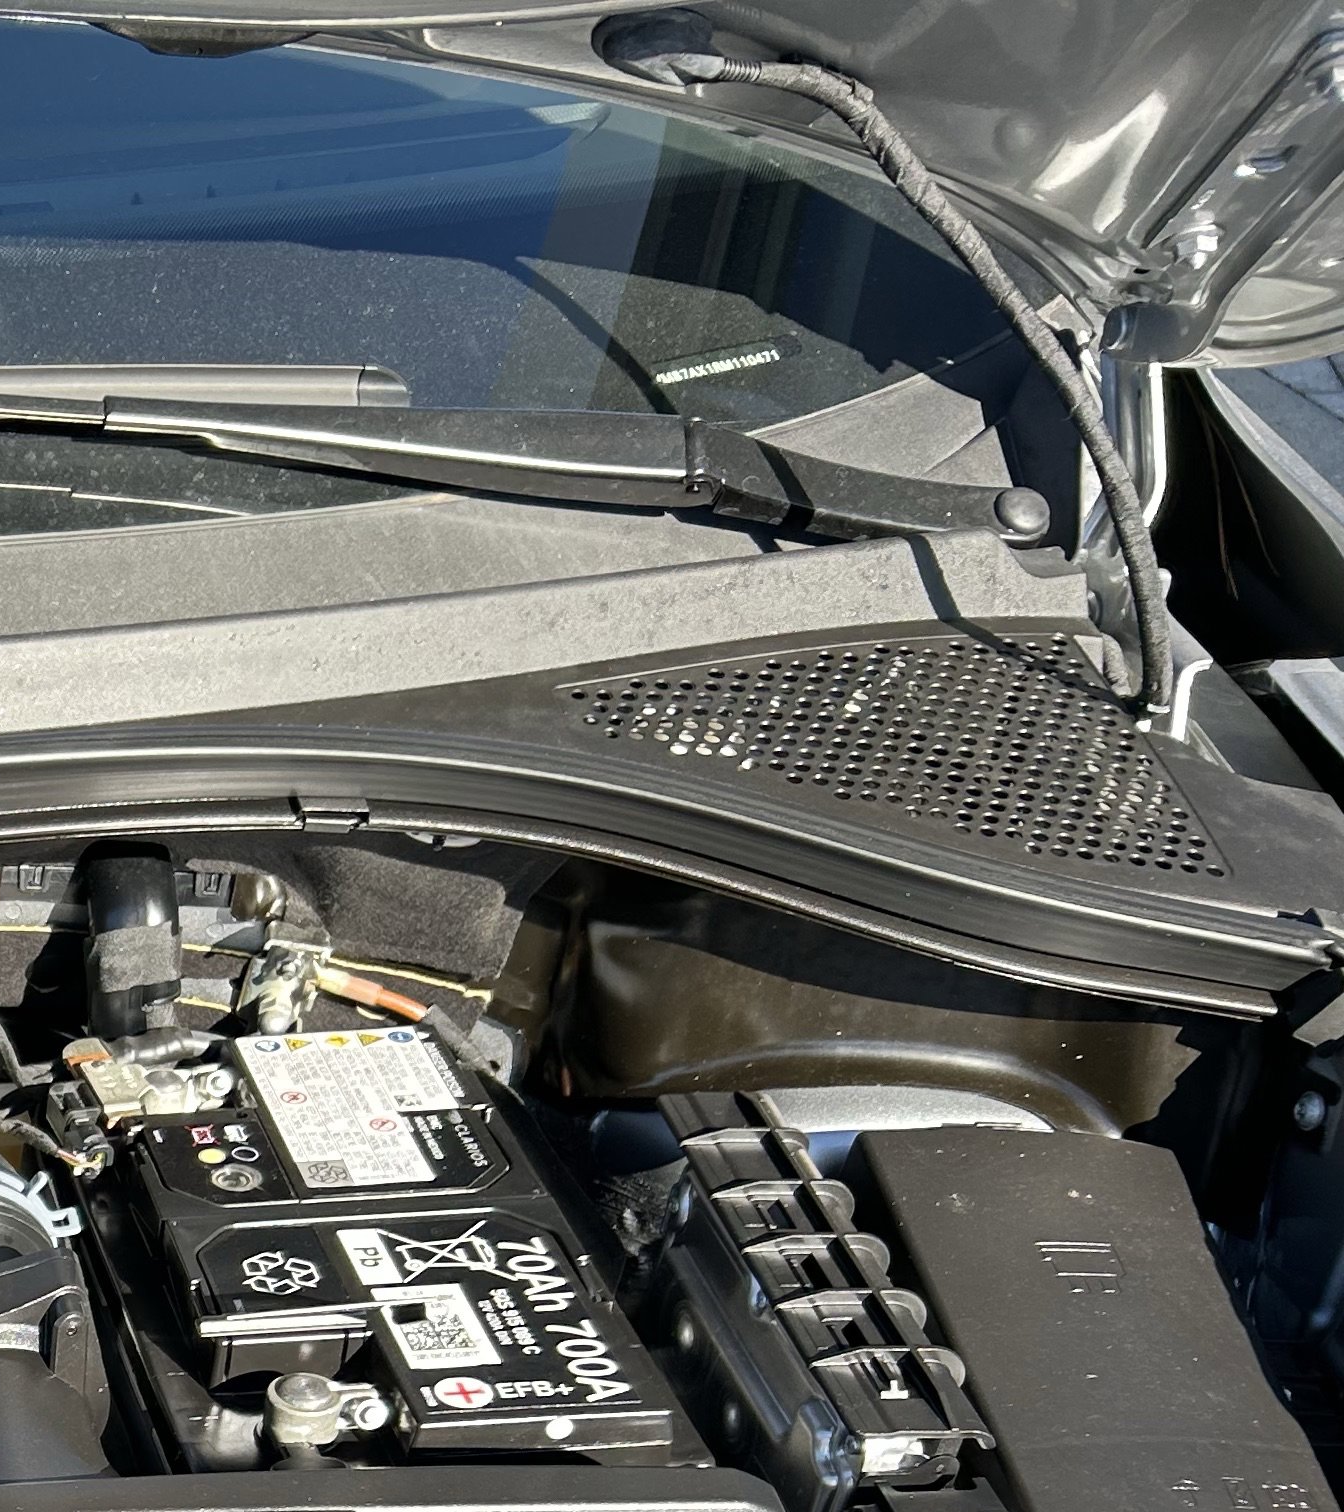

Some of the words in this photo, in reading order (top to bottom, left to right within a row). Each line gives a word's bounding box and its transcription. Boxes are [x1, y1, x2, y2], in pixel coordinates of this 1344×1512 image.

[454, 1124, 488, 1167] CLARIOS
[353, 1246, 380, 1268] Pb
[497, 1236, 577, 1312] 70Ah
[545, 1319, 632, 1403] 700A
[494, 1380, 577, 1400] EFB+
